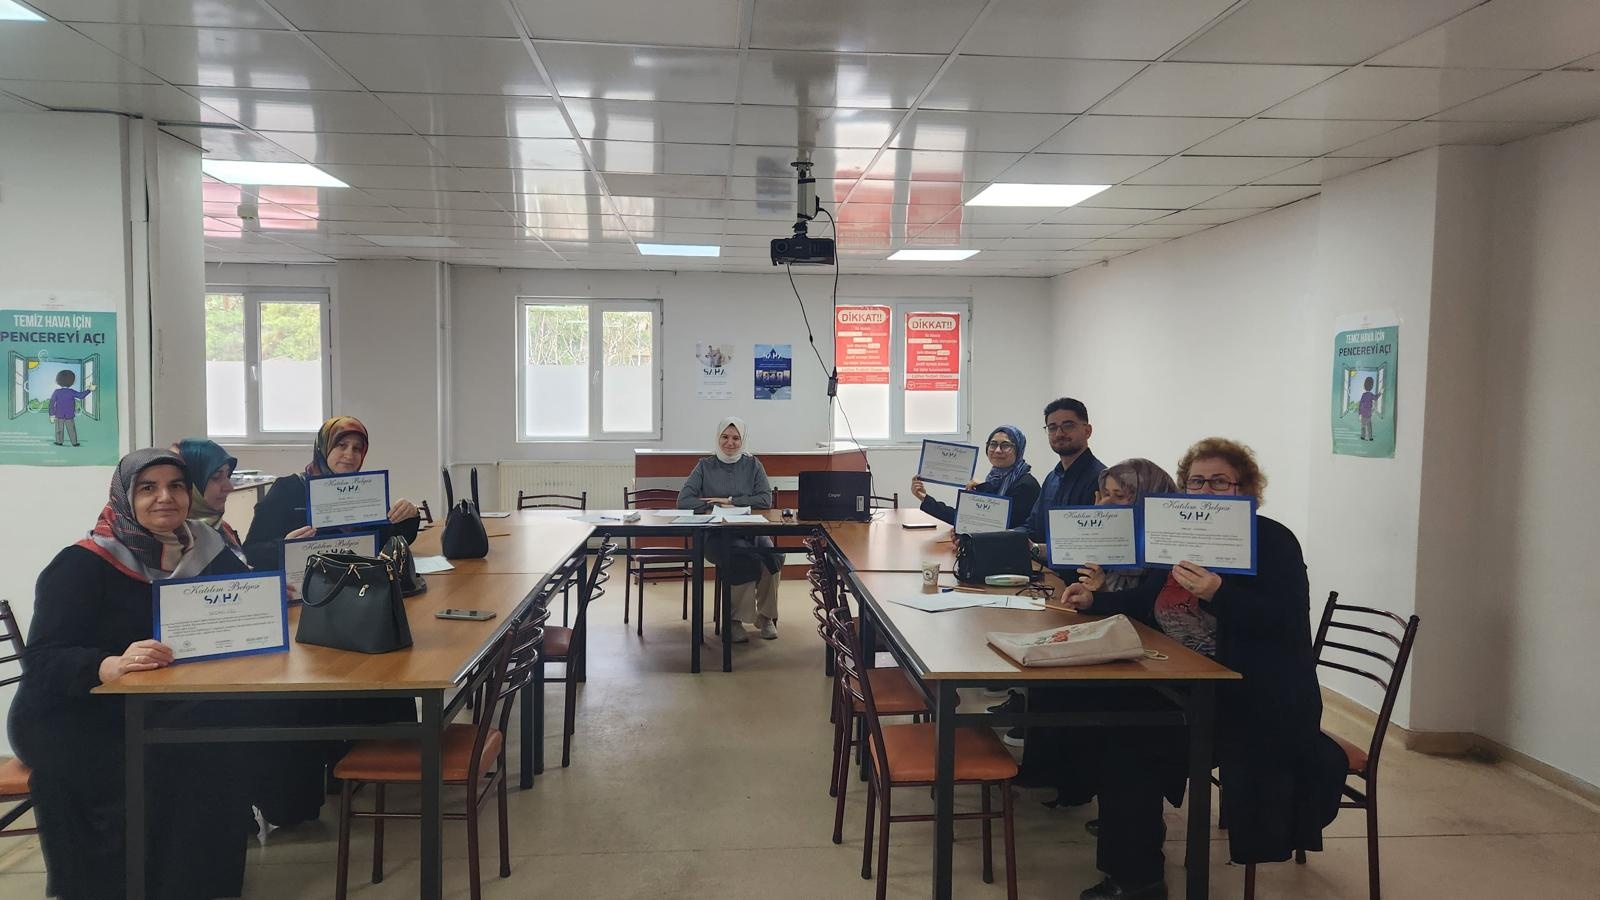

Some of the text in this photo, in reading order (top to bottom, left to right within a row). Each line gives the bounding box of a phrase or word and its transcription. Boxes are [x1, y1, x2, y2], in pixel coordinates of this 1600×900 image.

[13, 314, 92, 330] TEMİZ HAVA İÇİN
[841, 311, 882, 322] DİKKAT!!
[912, 318, 953, 329] DİKKAT!!
[0, 330, 105, 347] PENCEREYİ AÇ!
[1338, 342, 1379, 357] PENCEREYİ
